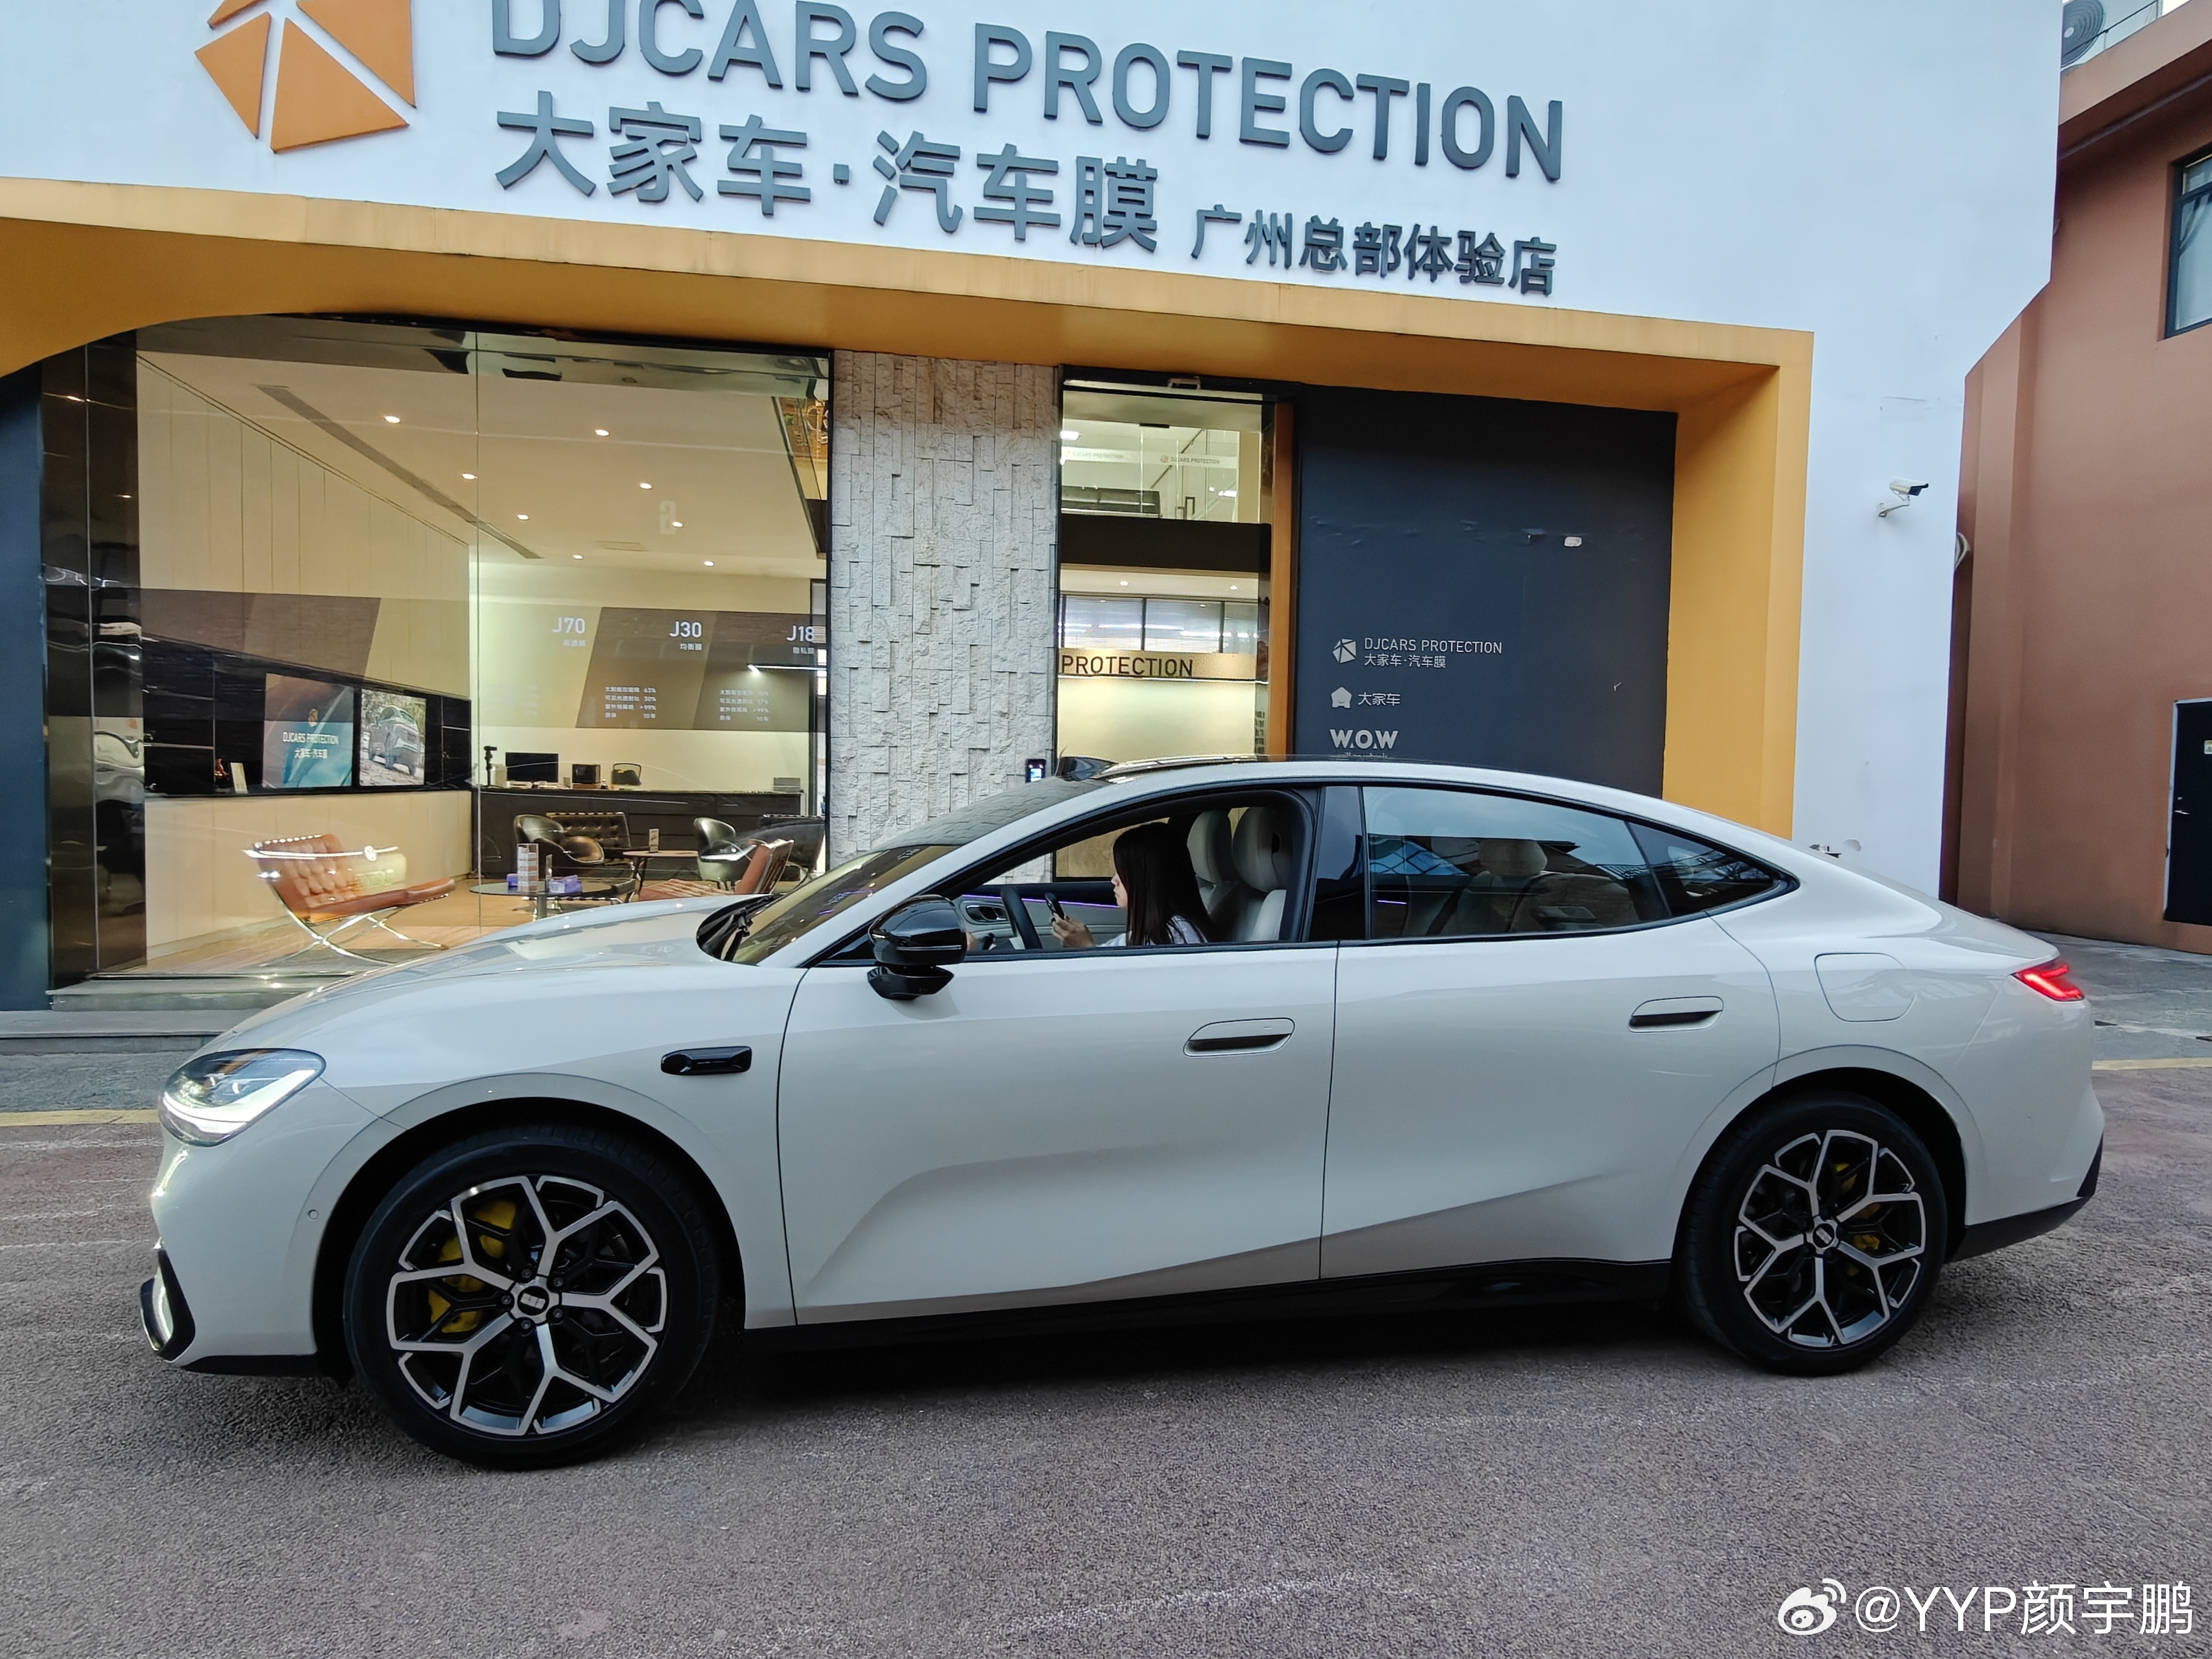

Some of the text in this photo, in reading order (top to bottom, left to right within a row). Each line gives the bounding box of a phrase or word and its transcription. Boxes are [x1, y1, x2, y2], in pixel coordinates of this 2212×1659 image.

[492, 0, 1562, 185] DJCARS PROTECTION
[495, 91, 1557, 295] 大家车·汽车膜 广州总部体验店
[552, 617, 585, 634] J70
[669, 621, 702, 638] J30
[786, 625, 814, 642] J18
[1364, 637, 1502, 654] DJCARS PROTECTION
[1061, 655, 1193, 676] PROTECTION
[1358, 692, 1401, 706] 大家车
